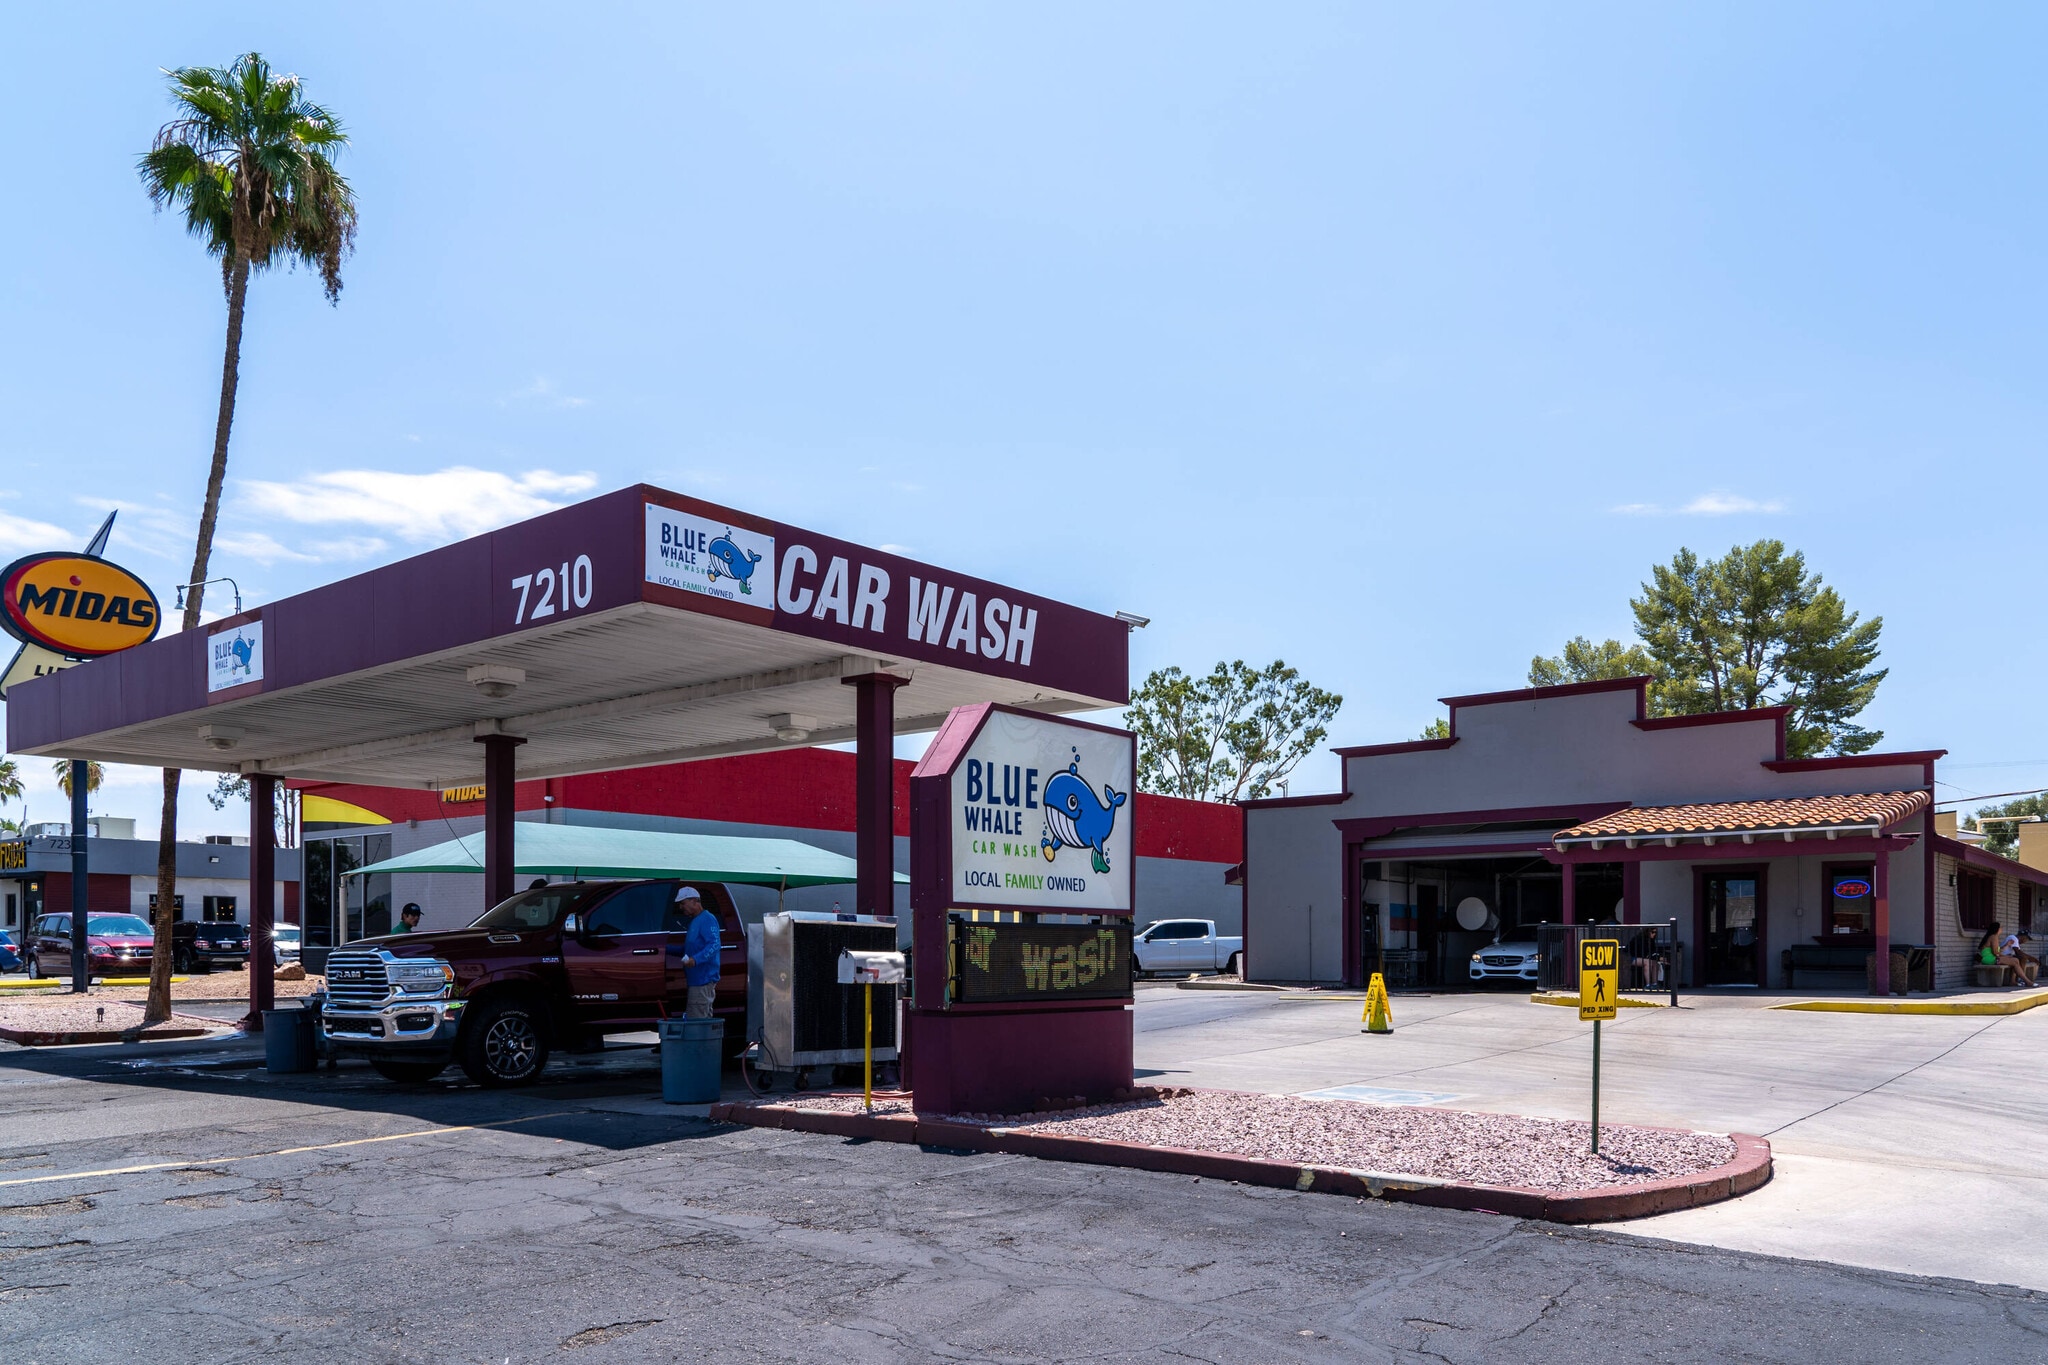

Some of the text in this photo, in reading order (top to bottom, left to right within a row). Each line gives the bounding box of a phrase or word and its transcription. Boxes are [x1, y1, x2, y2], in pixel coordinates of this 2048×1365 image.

[661, 522, 706, 553] BLUE
[660, 545, 696, 565] WHALE
[665, 560, 706, 575] CAR WASH
[511, 554, 593, 625] 7210
[659, 576, 734, 600] LOCAL FAMILY OWNED
[18, 582, 155, 628] MIDAS
[777, 544, 1038, 667] CAR WASH
[214, 641, 232, 660] BLUE
[34, 664, 67, 677] LI
[966, 758, 1039, 809] BLUE
[964, 805, 1022, 836] WHALE
[972, 840, 1037, 858] CAR WASH
[965, 870, 1086, 893] LOCAL FAMILY OWNED
[1836, 883, 1868, 895] OPEN
[1585, 946, 1614, 967] SLOW
[335, 970, 361, 978] RAM
[1583, 1005, 1614, 1014] PED XING
